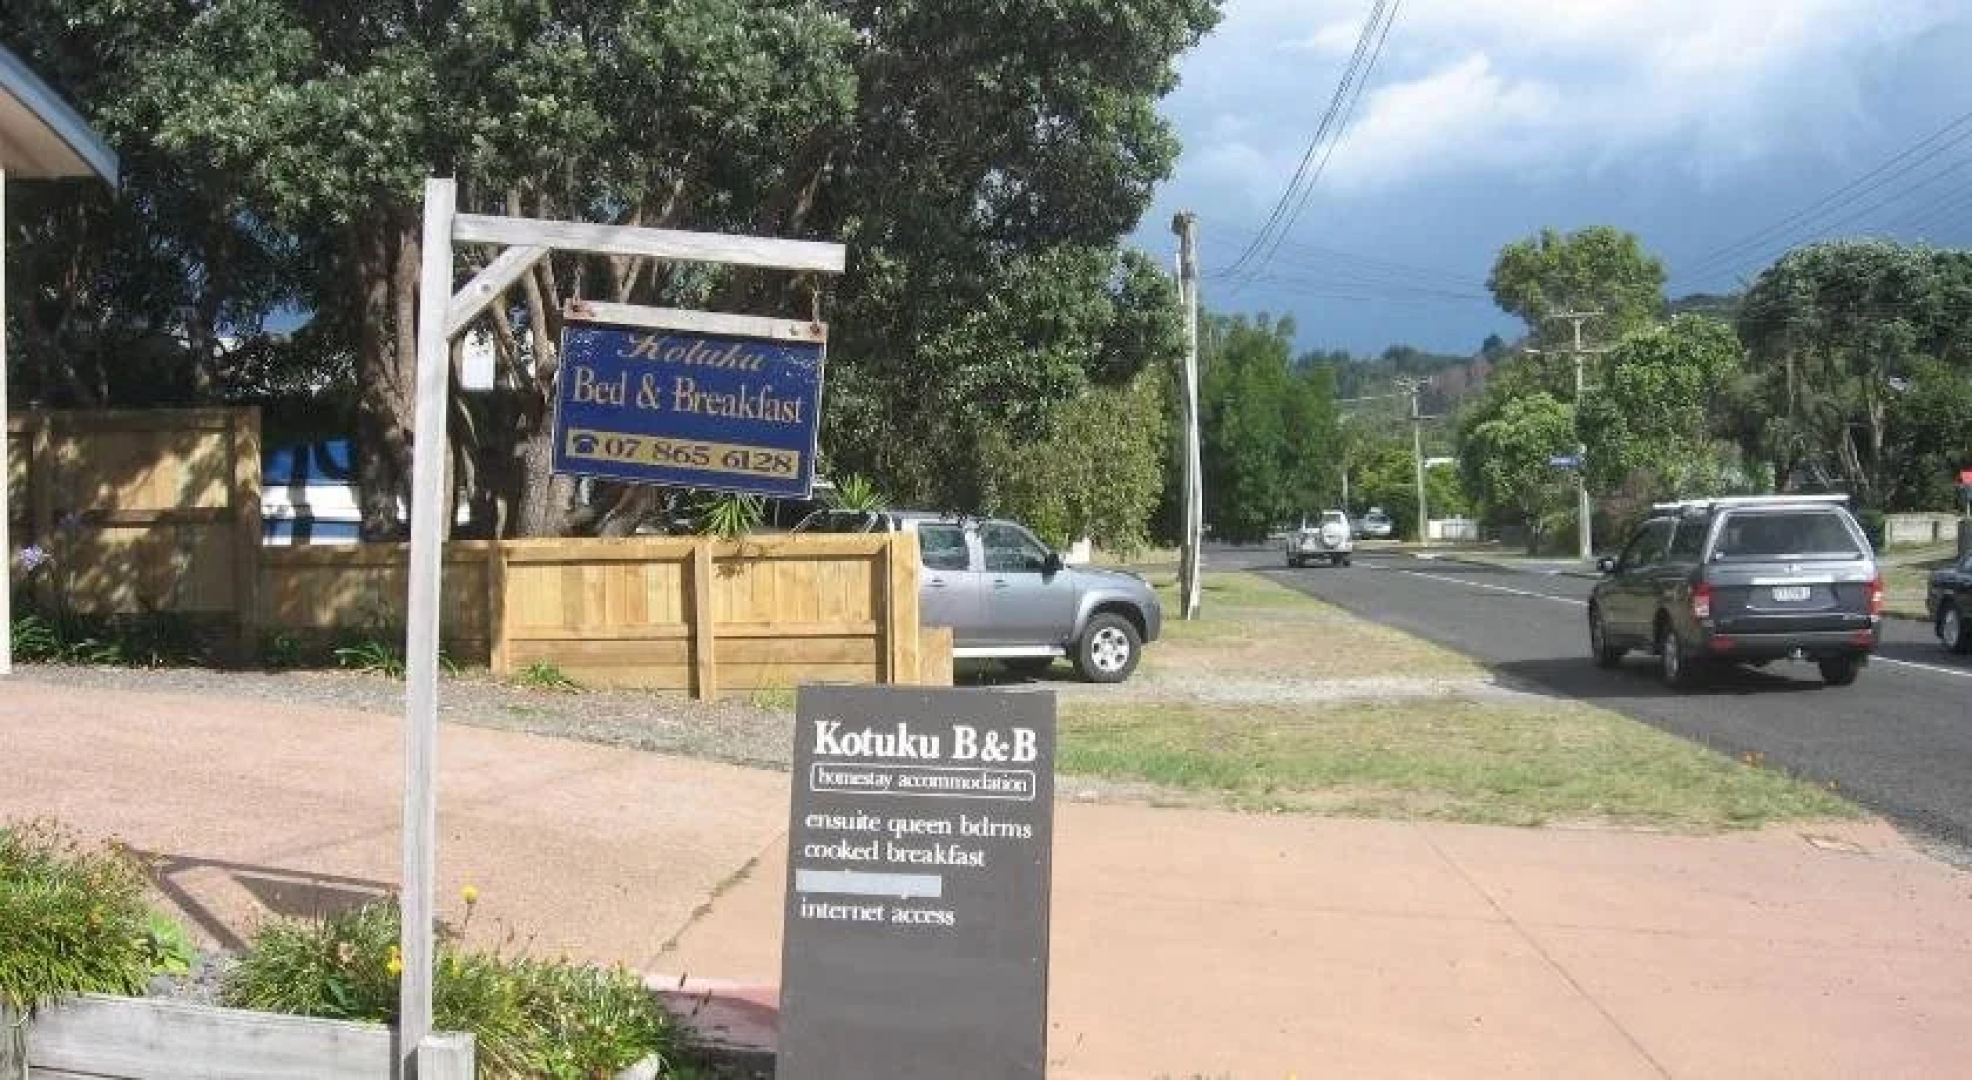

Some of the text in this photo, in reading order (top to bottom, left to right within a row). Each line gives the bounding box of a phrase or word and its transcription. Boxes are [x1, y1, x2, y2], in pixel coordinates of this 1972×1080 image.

[617, 333, 766, 371] Kotuku
[573, 366, 803, 424] Bed & Breakfast
[605, 438, 792, 474] 07 865 6128
[813, 720, 1038, 762] Kotuku B&B
[818, 767, 1027, 793] homestay accommodation
[805, 810, 1032, 839] ensuite queen bdrms
[804, 839, 986, 867] cooked breakfast
[801, 898, 956, 926] internet access
